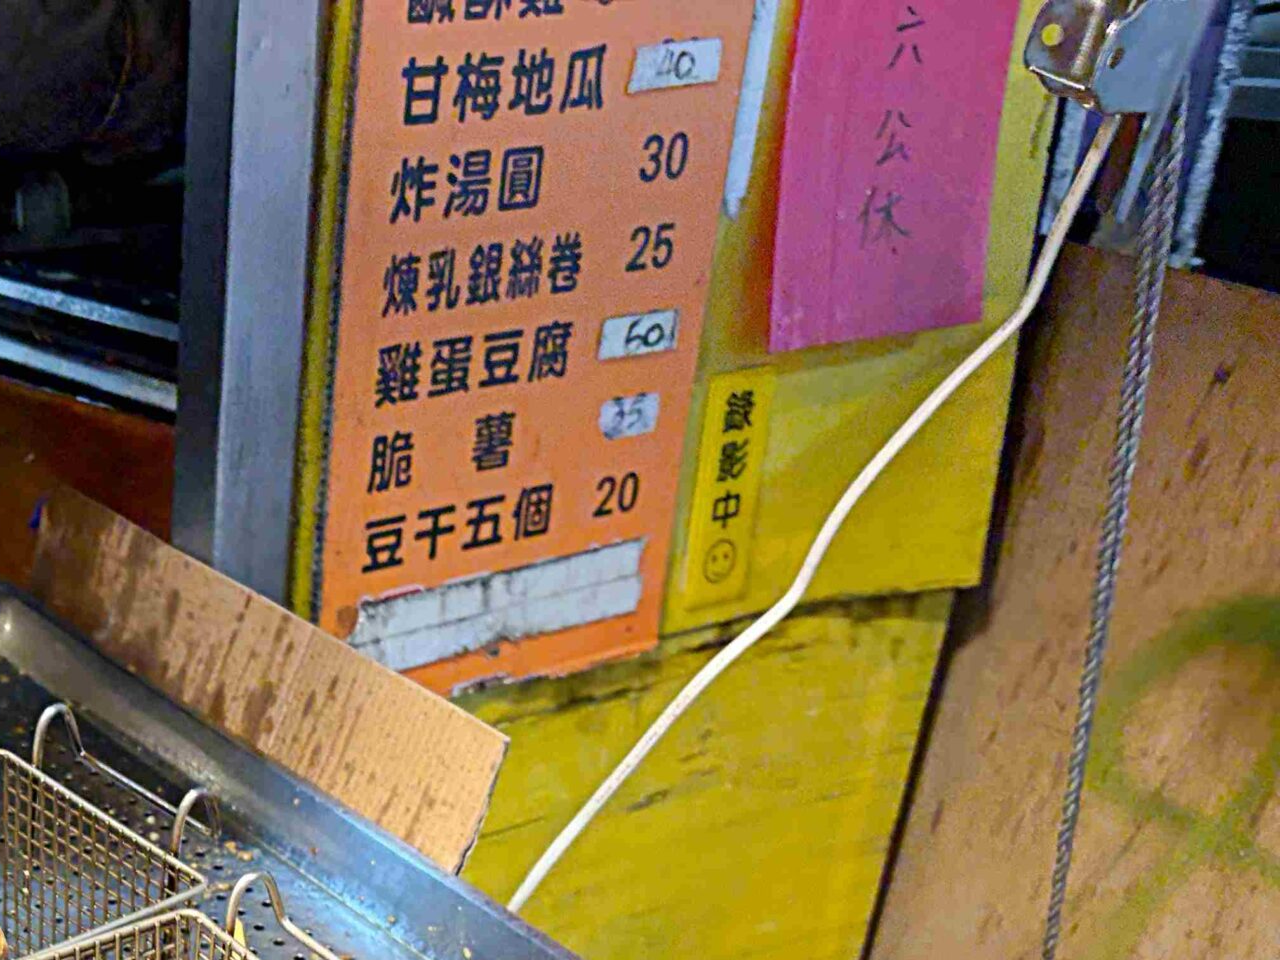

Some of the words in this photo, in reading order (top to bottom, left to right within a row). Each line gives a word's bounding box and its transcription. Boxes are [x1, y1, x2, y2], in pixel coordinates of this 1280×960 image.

[401, 44, 607, 126] 甘梅地瓜
[389, 145, 545, 224] 炸湯圓
[639, 131, 689, 183] 30
[625, 222, 676, 273] 25
[374, 320, 574, 408] 雞蛋豆腐
[361, 484, 554, 574] 豆干五個
[592, 471, 640, 519] 20
